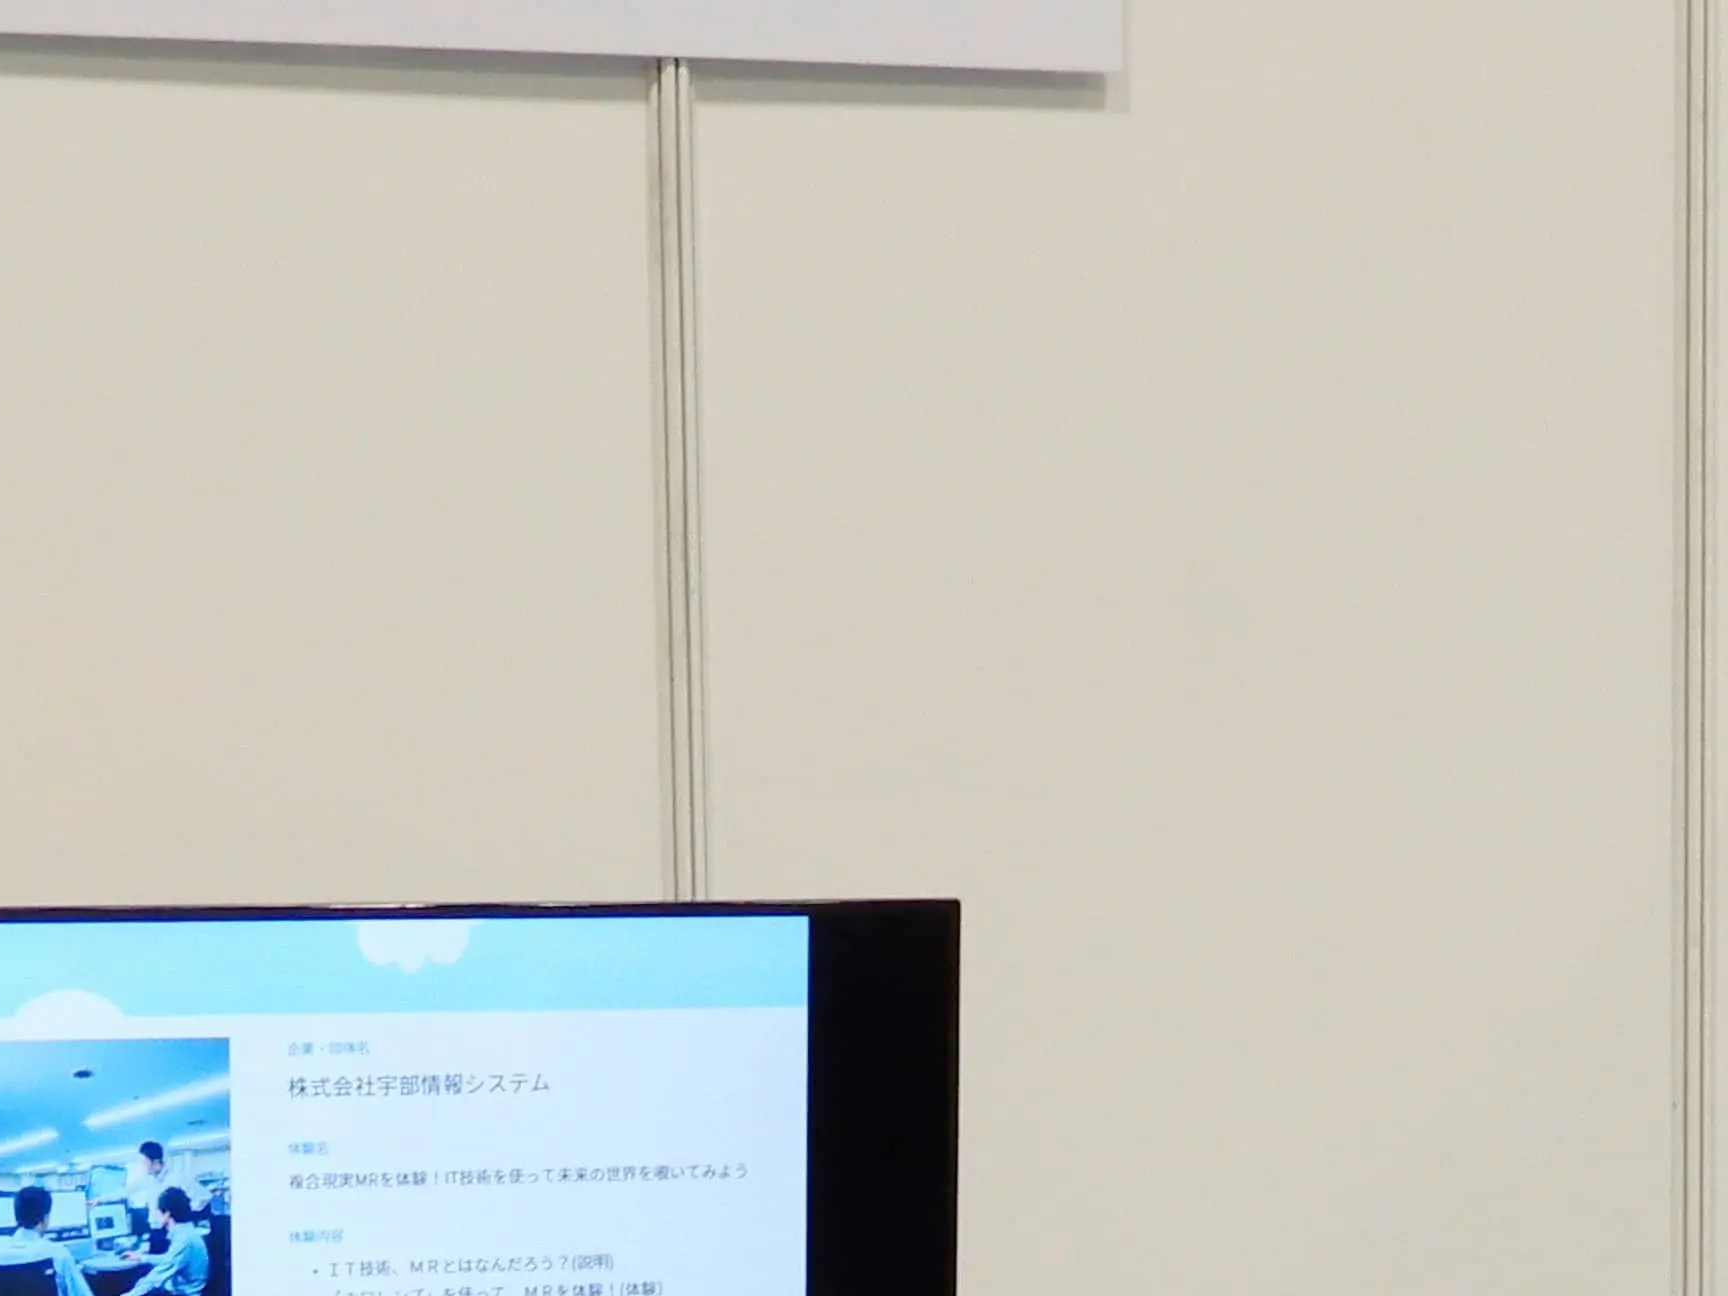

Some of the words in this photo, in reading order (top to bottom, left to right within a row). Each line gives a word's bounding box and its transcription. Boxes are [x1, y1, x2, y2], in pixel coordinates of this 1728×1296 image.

[288, 1073, 550, 1099] 株式会社宇部情報システム
